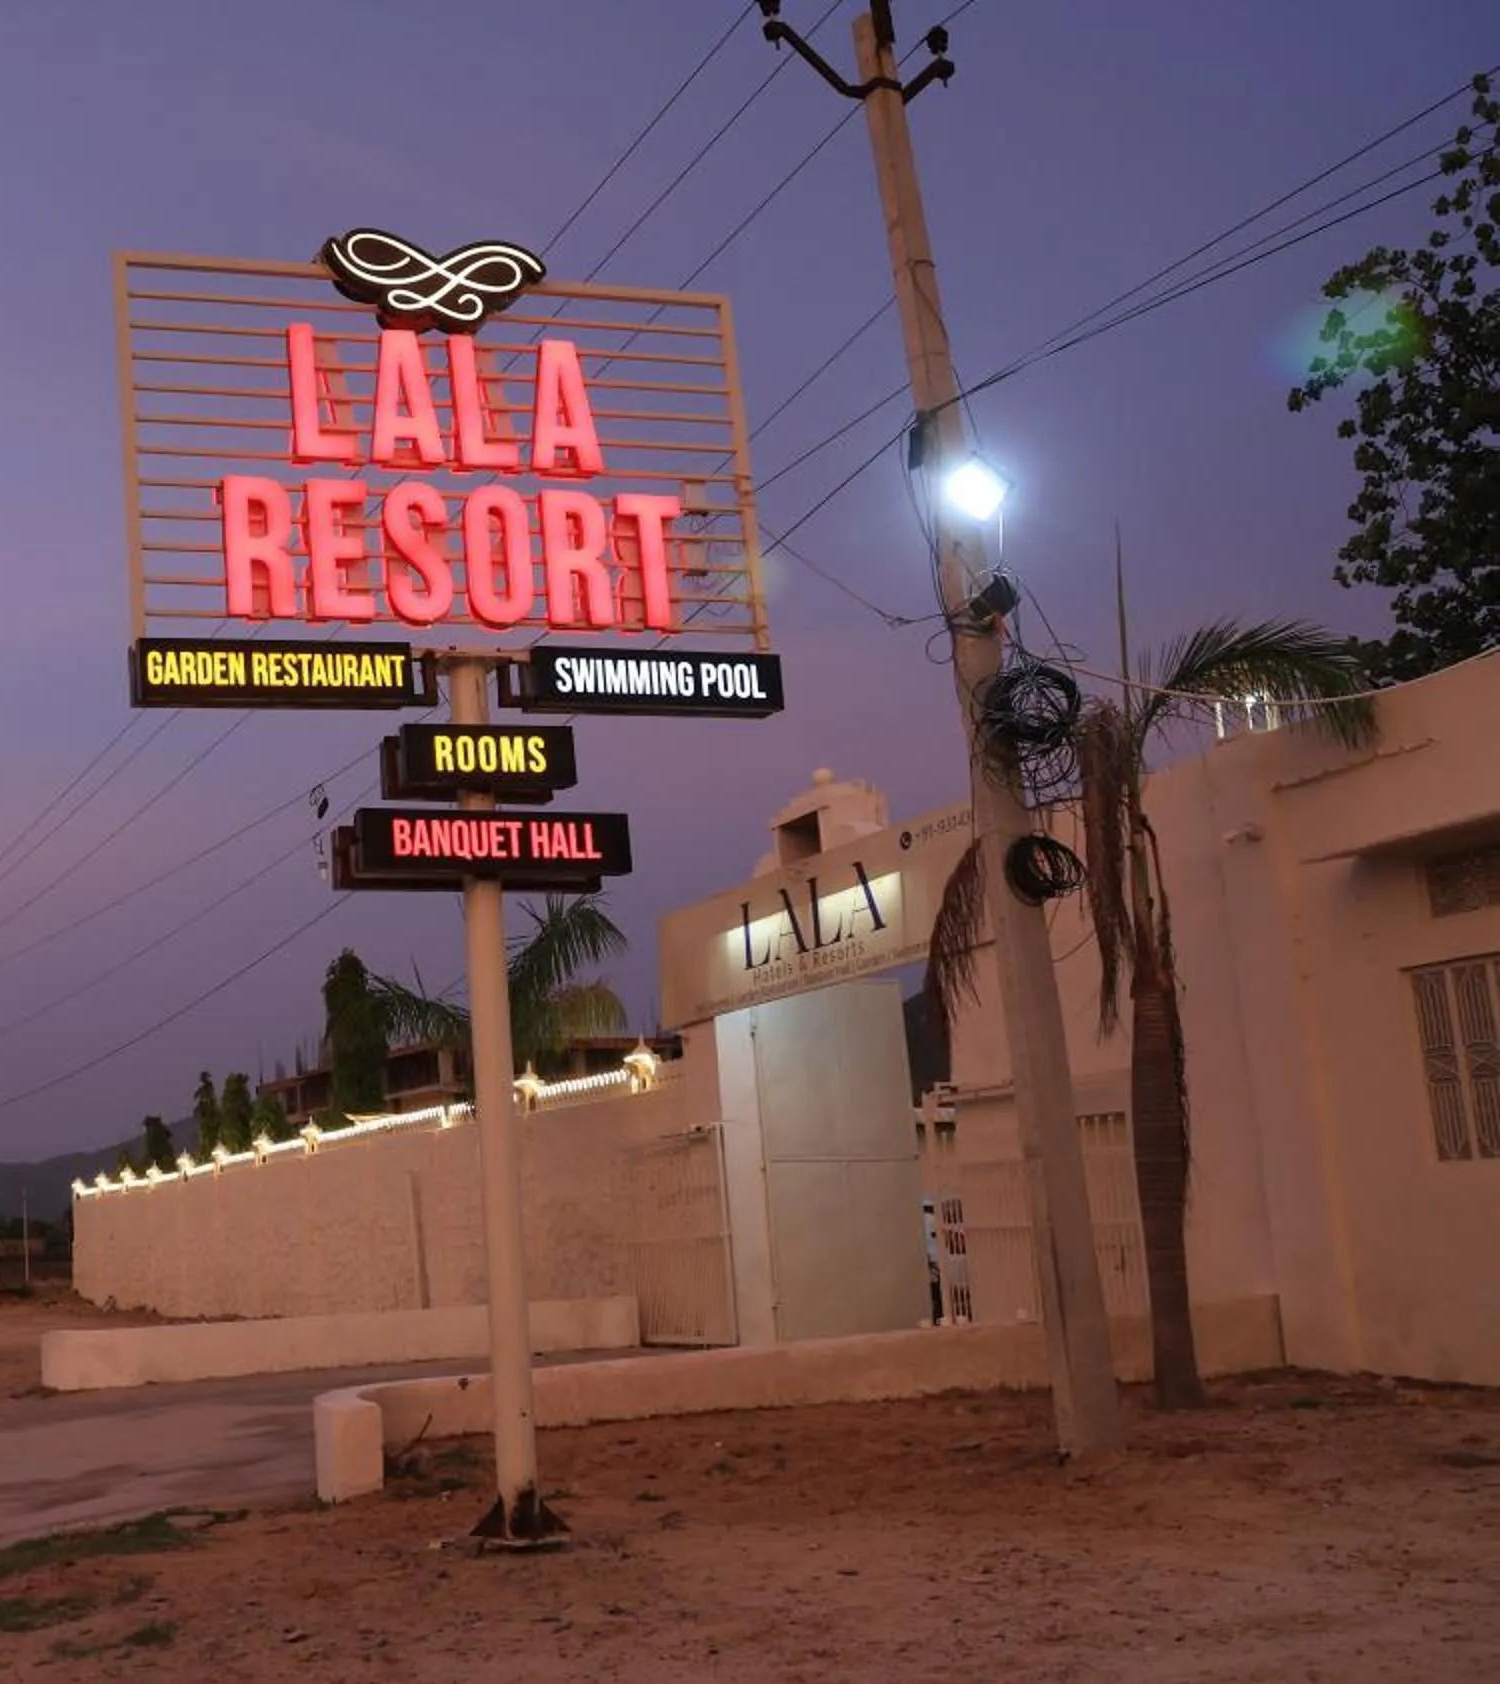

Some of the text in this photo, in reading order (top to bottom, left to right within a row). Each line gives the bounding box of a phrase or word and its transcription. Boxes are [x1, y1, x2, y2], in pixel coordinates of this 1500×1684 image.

[286, 323, 604, 476] LALA
[218, 475, 682, 634] RESORT
[146, 650, 405, 688] GARDEN RESTAURANT
[554, 657, 768, 699] SWIMMING POOL
[434, 735, 547, 773] ROOMS
[392, 818, 602, 860] BANQUET HALL
[741, 861, 886, 970] LALA
[813, 941, 864, 967] Resorts
